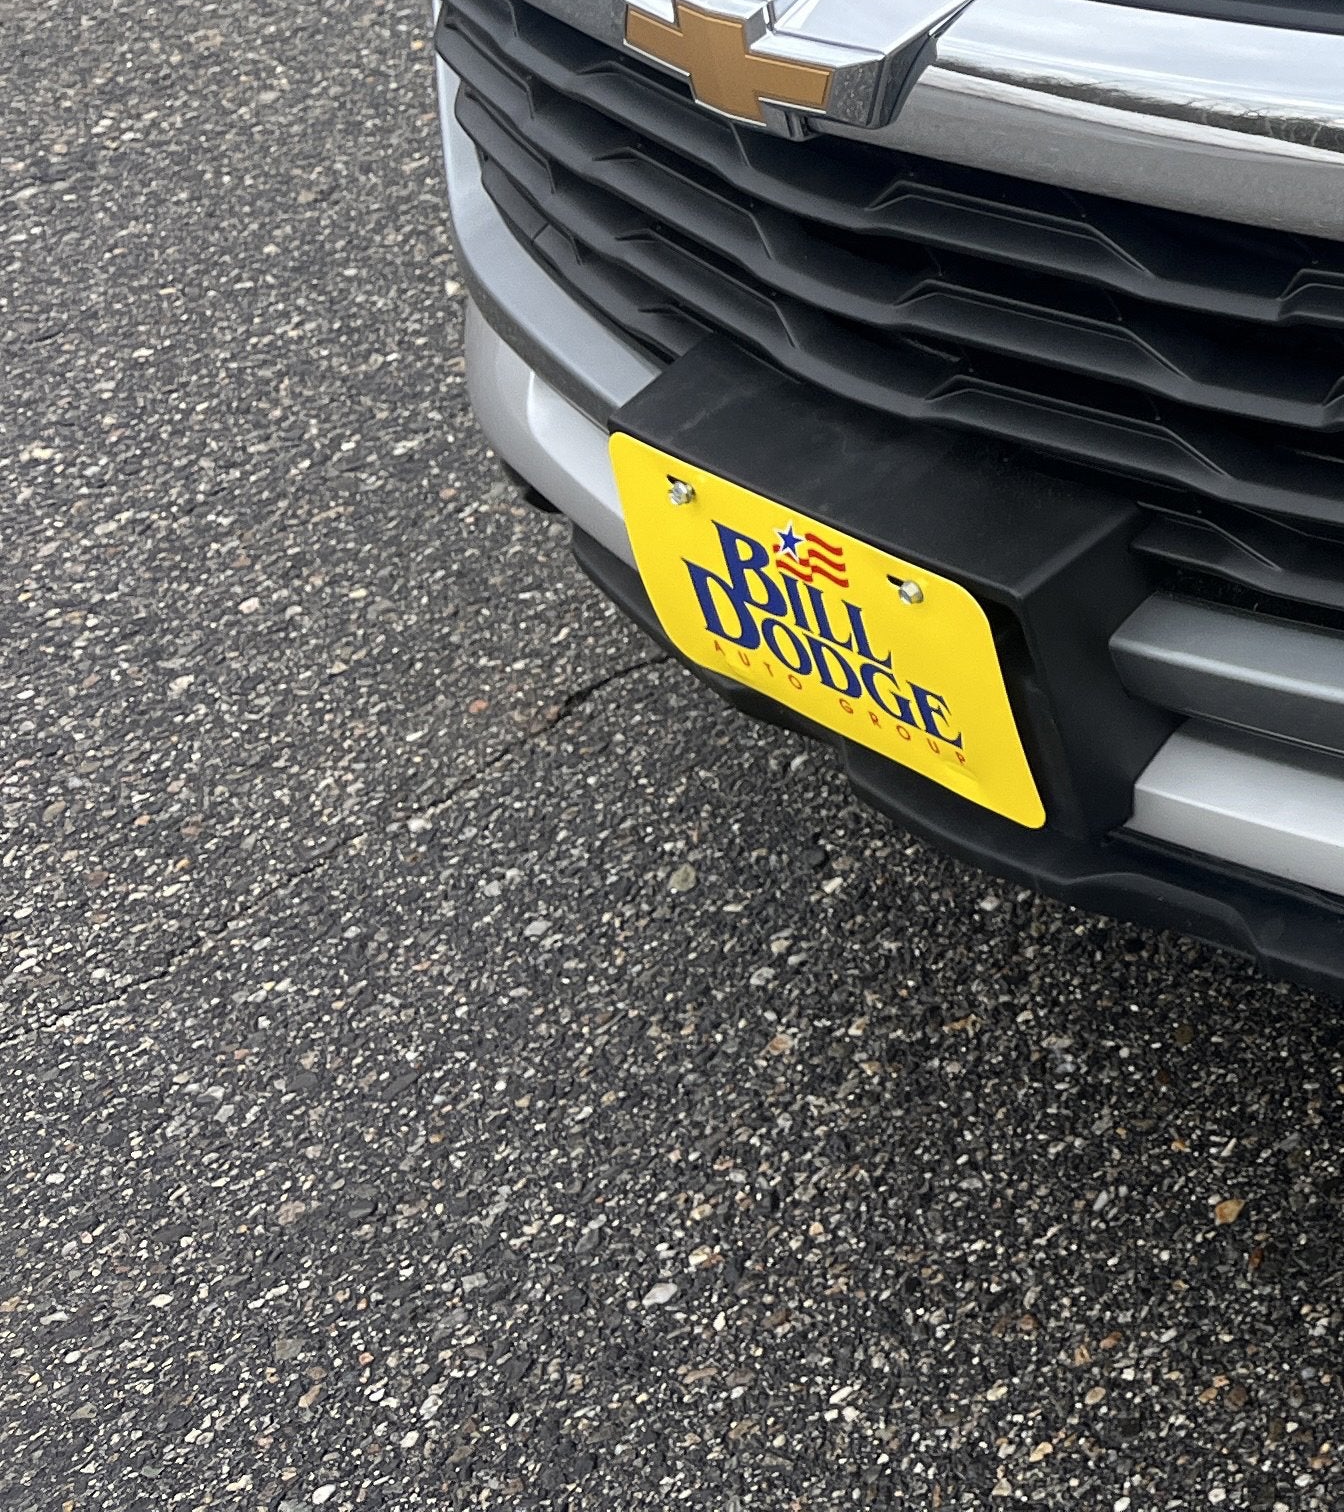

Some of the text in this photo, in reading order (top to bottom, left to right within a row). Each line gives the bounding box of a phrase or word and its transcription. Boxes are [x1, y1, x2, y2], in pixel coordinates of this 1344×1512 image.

[681, 557, 964, 750] DODGE
[711, 519, 892, 670] BILL
[713, 639, 966, 766] AUTO GROUP
